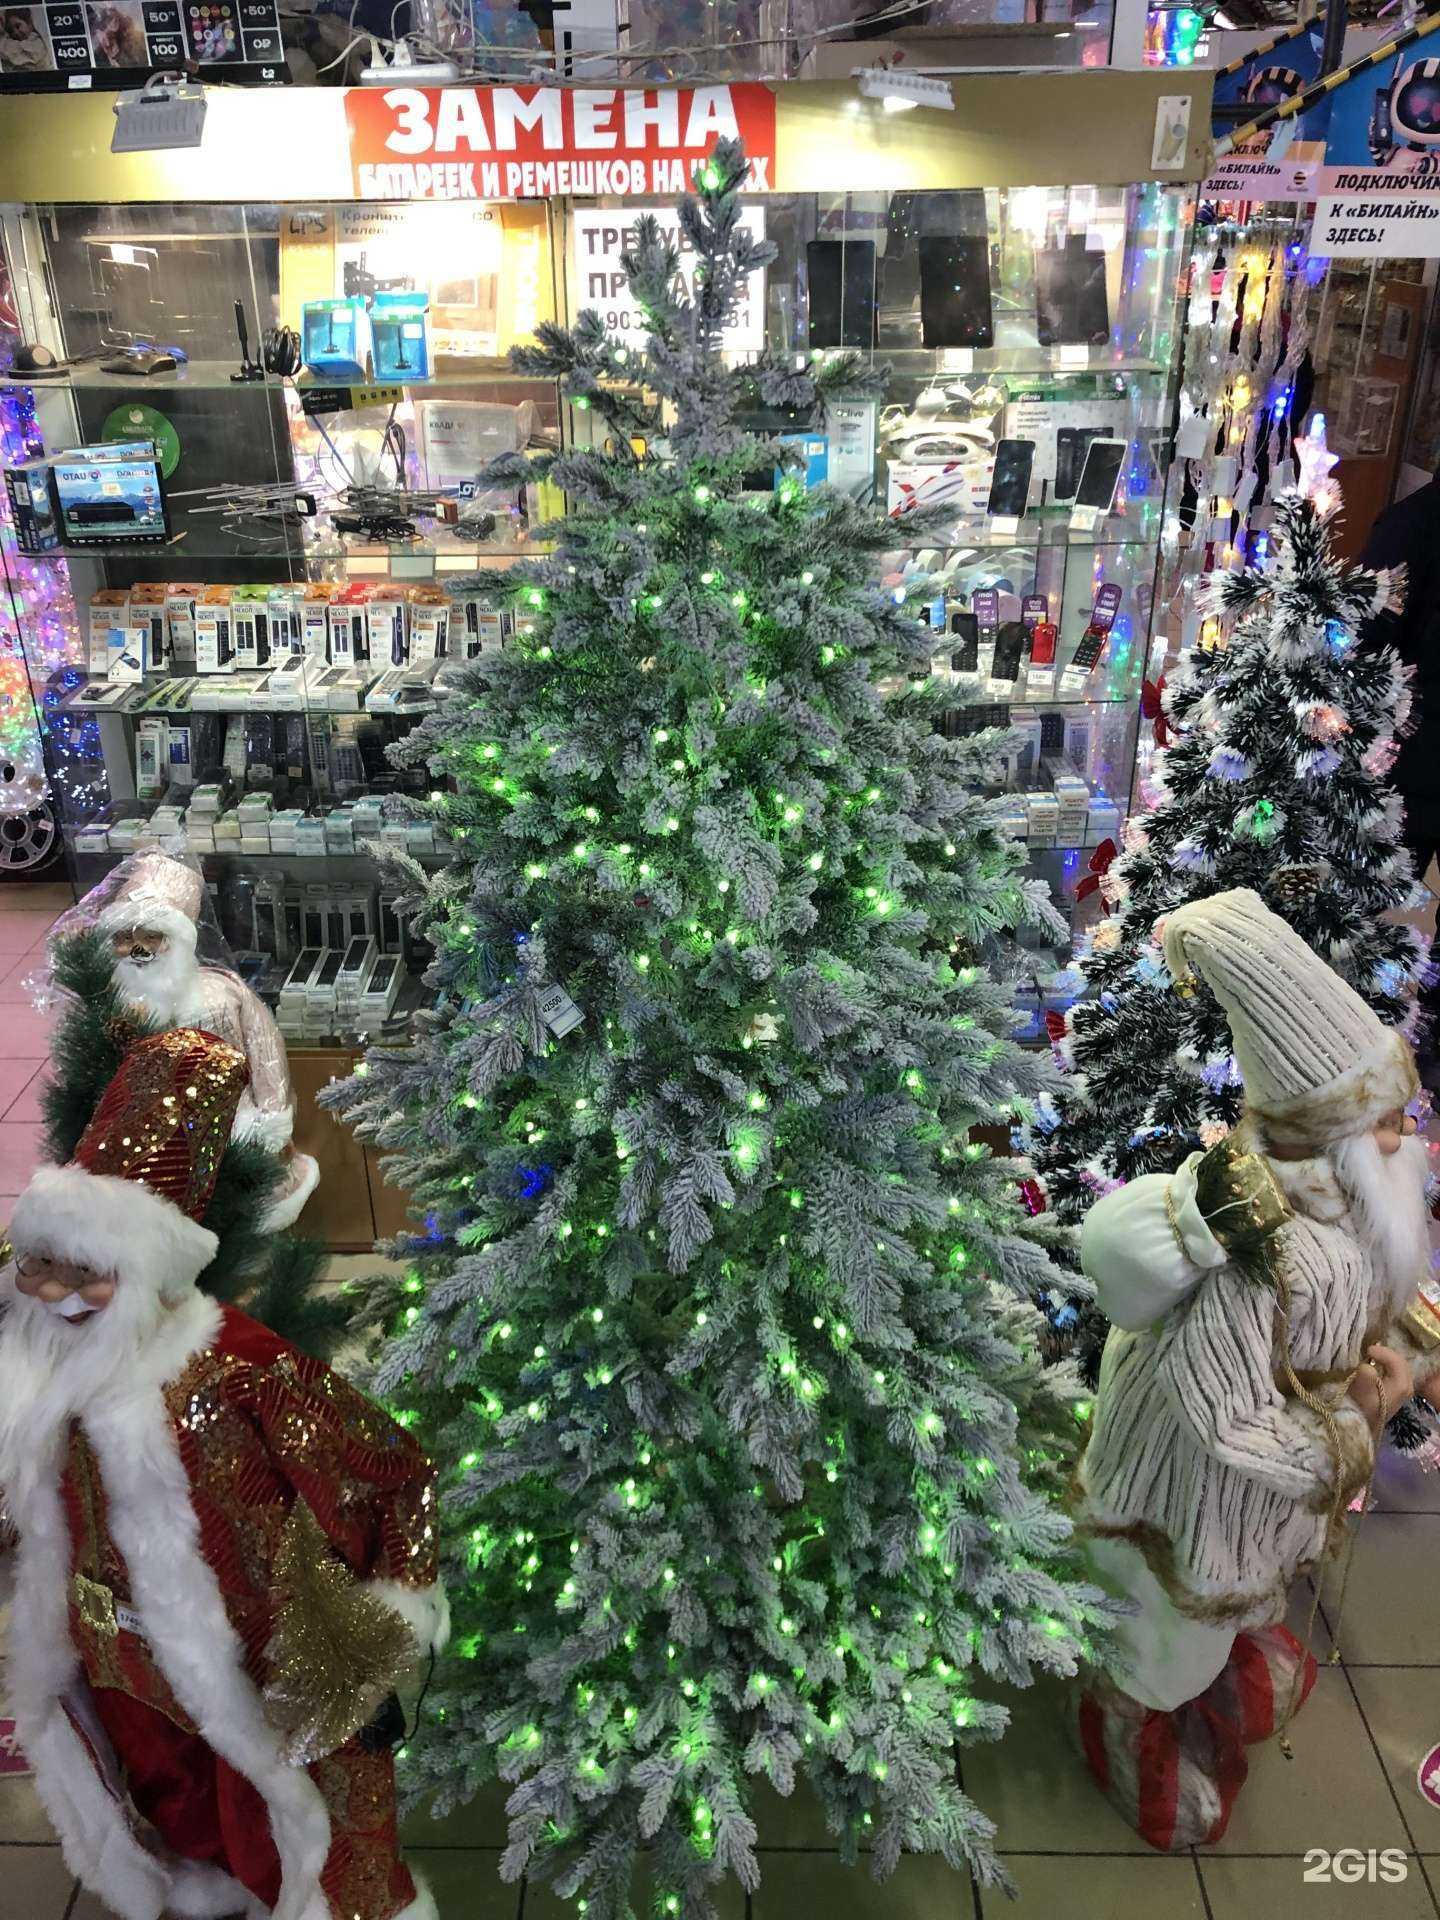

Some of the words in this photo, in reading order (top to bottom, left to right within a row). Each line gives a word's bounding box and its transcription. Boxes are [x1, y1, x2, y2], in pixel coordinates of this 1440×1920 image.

[58, 47, 87, 58] 400
[152, 44, 178, 56] 100
[383, 86, 740, 154] ЗАМЕНА
[1219, 162, 1281, 175] «БИЛАЙН»
[482, 162, 499, 197] И
[506, 159, 646, 197] РЕМЕШКОВ
[652, 158, 686, 193] НА
[1206, 180, 1244, 192] ЗДЕСЬ!
[1329, 203, 1344, 217] К
[1346, 200, 1439, 218] «БИЛАЙН»
[1326, 228, 1385, 245] ЗДЕСЬ!
[63, 472, 87, 481] OTAU
[542, 995, 562, 1013] 42500
